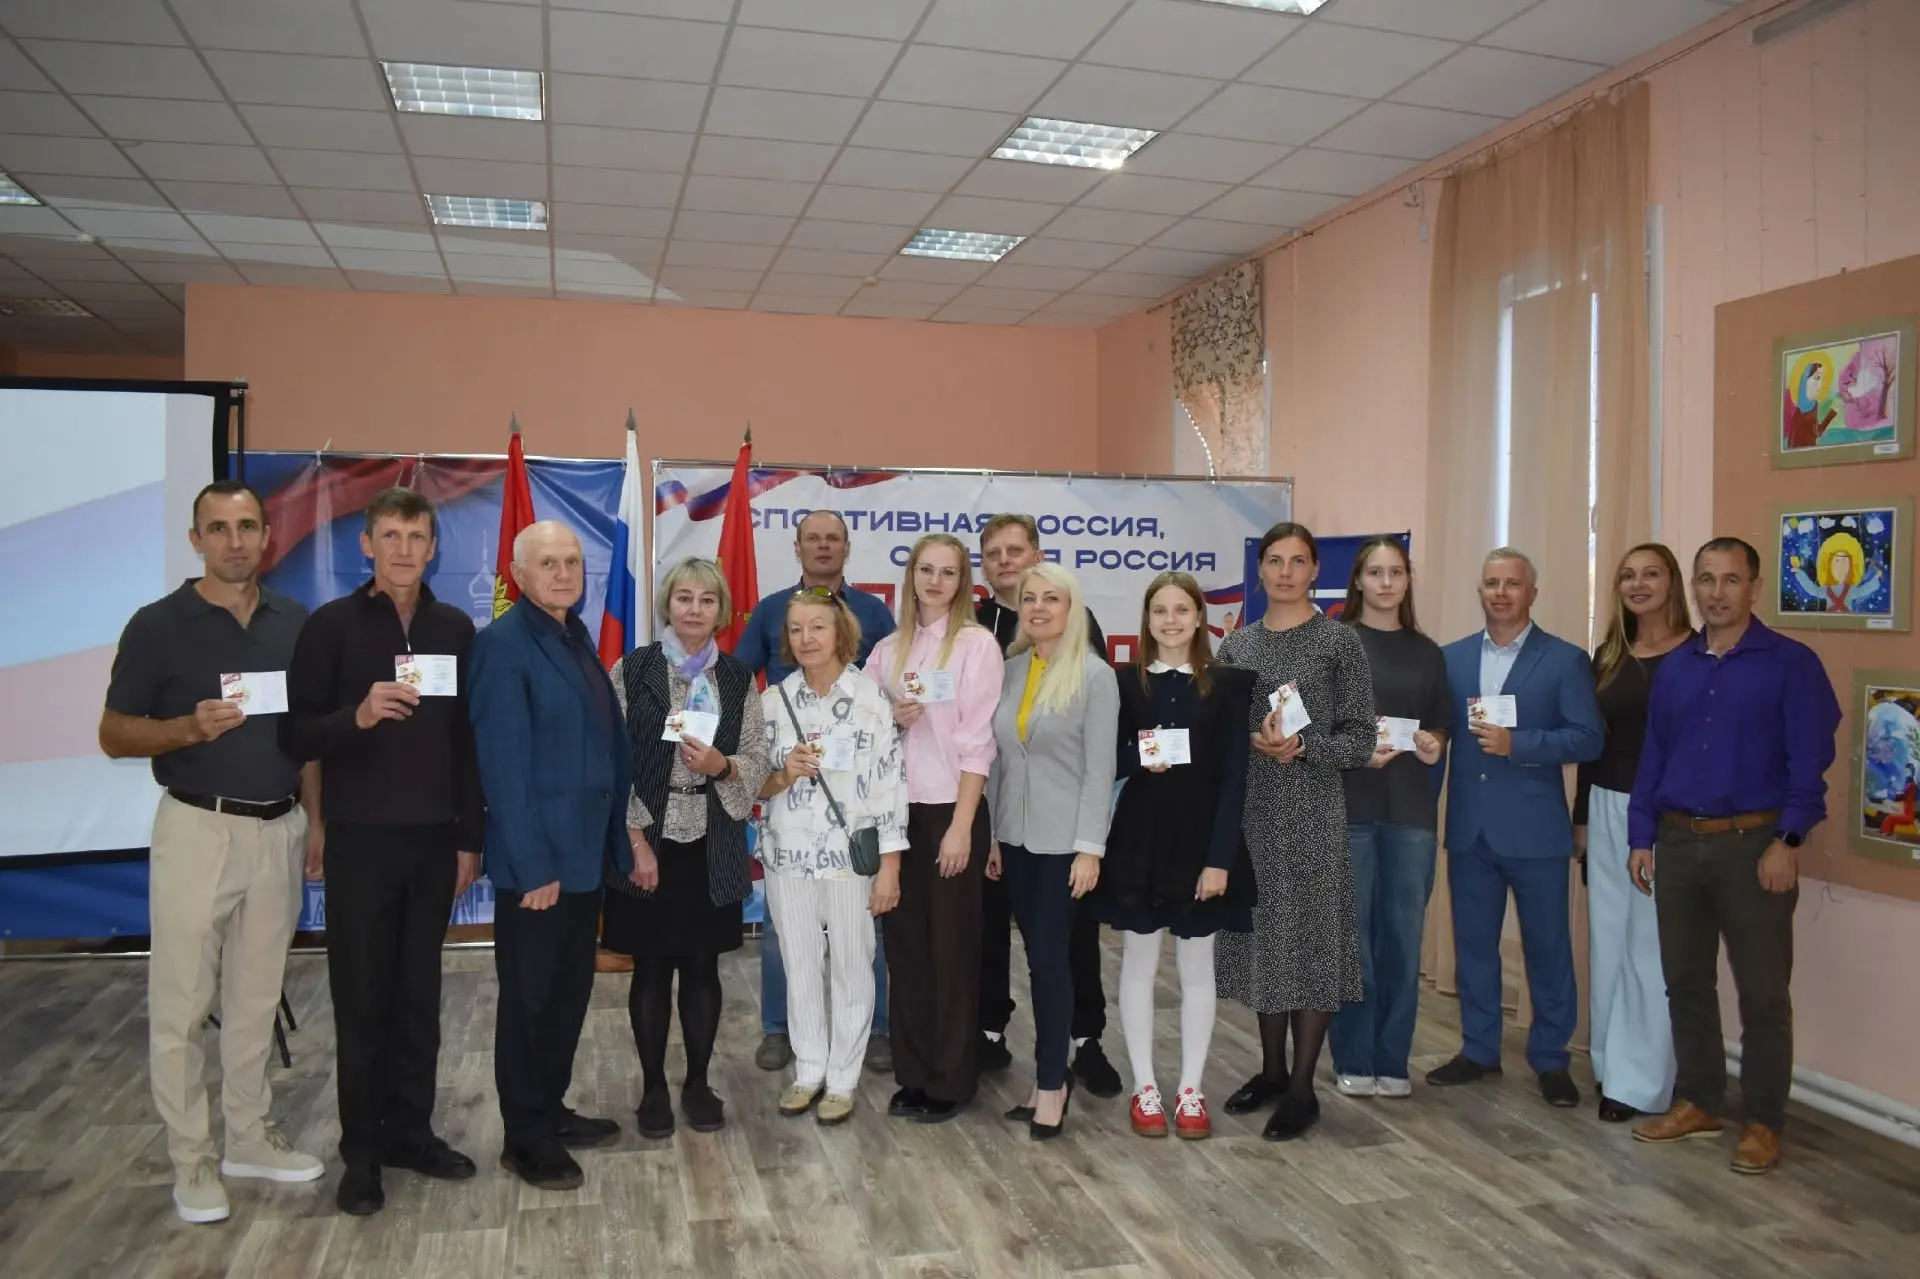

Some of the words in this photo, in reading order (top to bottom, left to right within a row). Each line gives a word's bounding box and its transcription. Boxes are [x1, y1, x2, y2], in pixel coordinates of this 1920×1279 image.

[751, 508, 995, 534] СПОТИВНАЯ
[1037, 514, 1165, 539] ОССИЯ,
[1075, 549, 1216, 572] РОССИЯ
